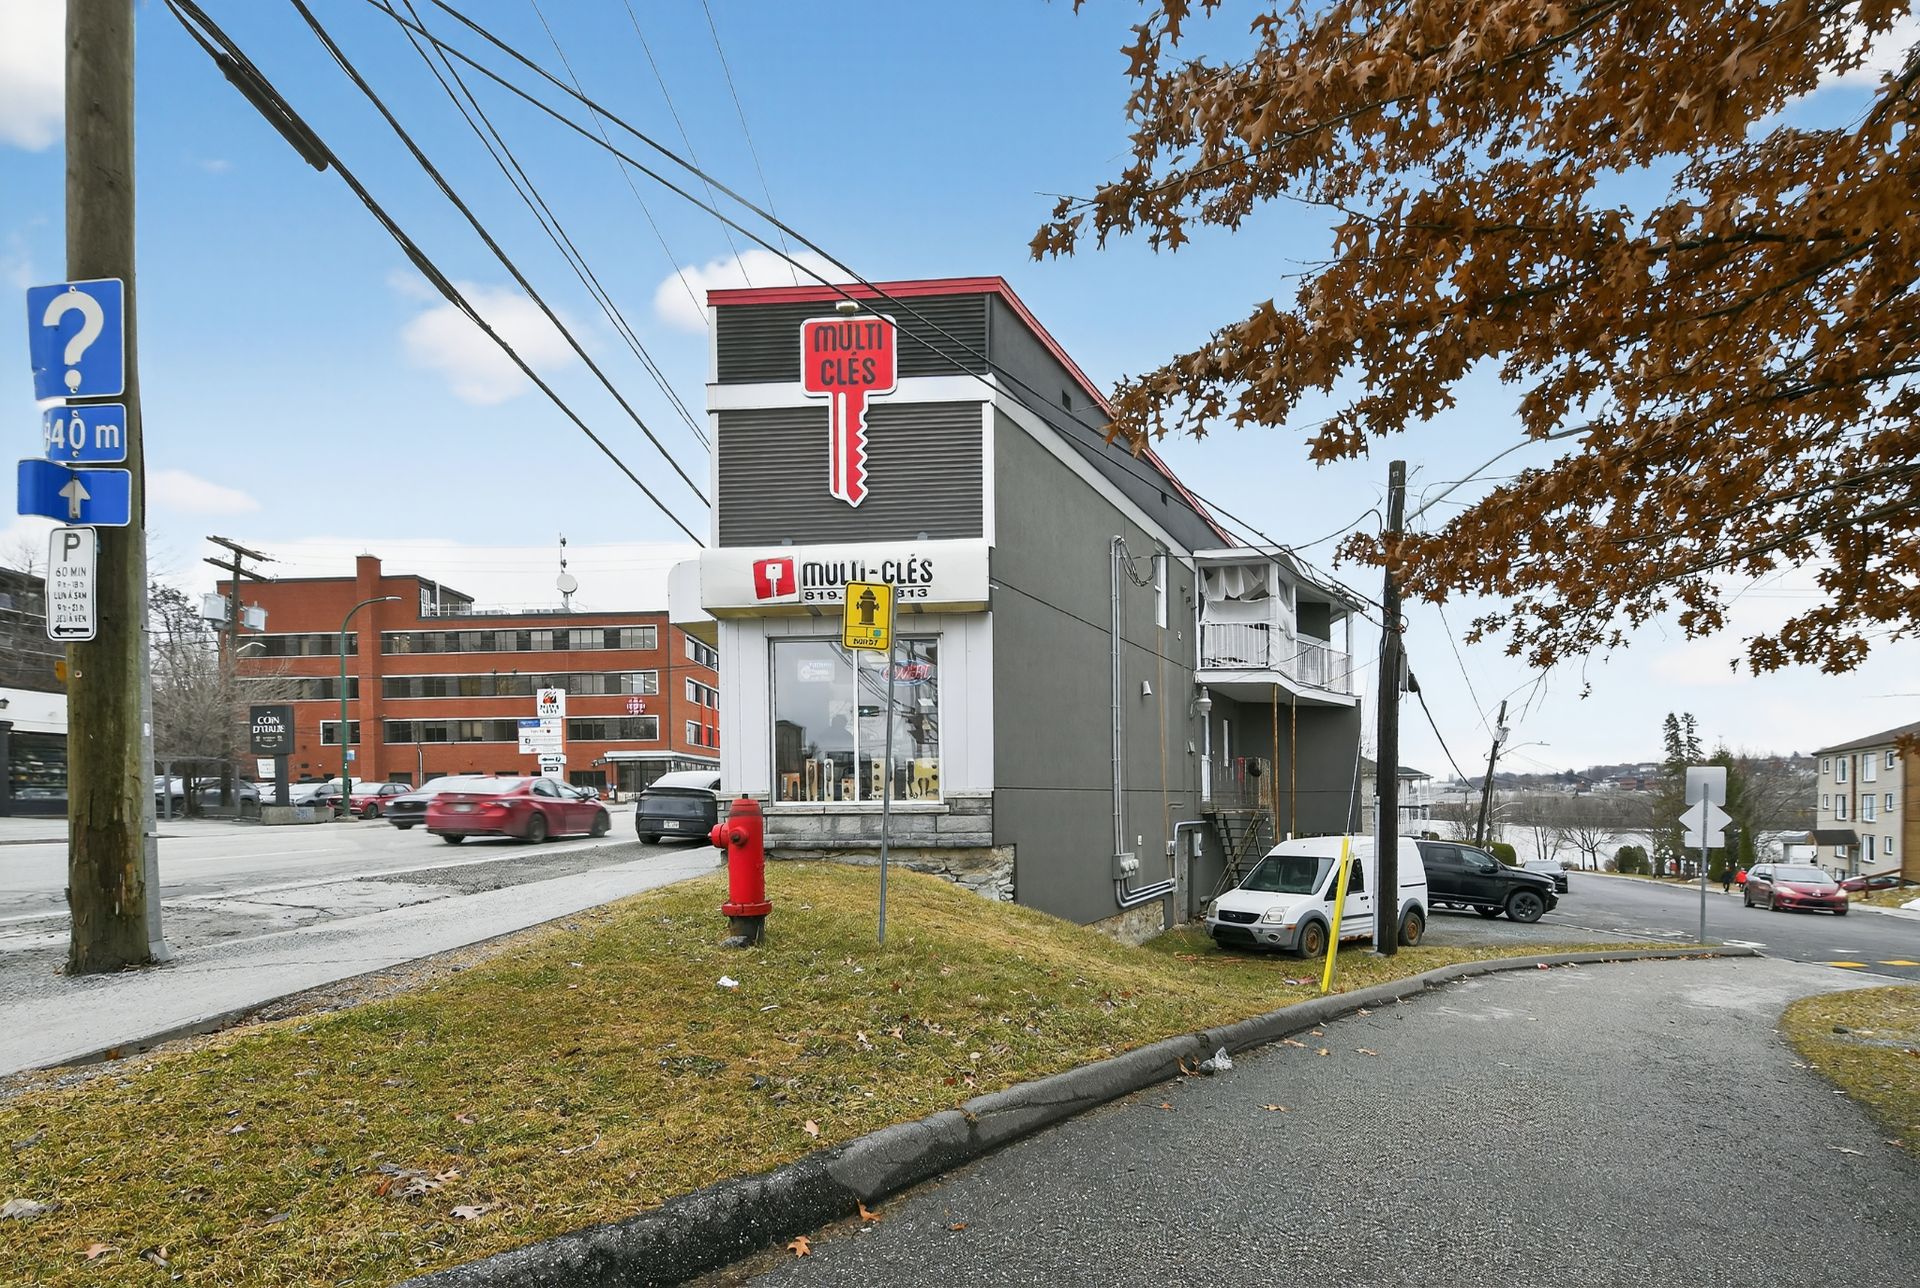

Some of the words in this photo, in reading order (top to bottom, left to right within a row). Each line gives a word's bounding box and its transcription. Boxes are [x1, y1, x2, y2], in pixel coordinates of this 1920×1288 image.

[814, 323, 882, 352] MULTI
[821, 352, 876, 386] CLÉS
[95, 424, 120, 449] m
[63, 533, 81, 562] P
[55, 566, 68, 578] 60
[70, 566, 87, 578] MIN
